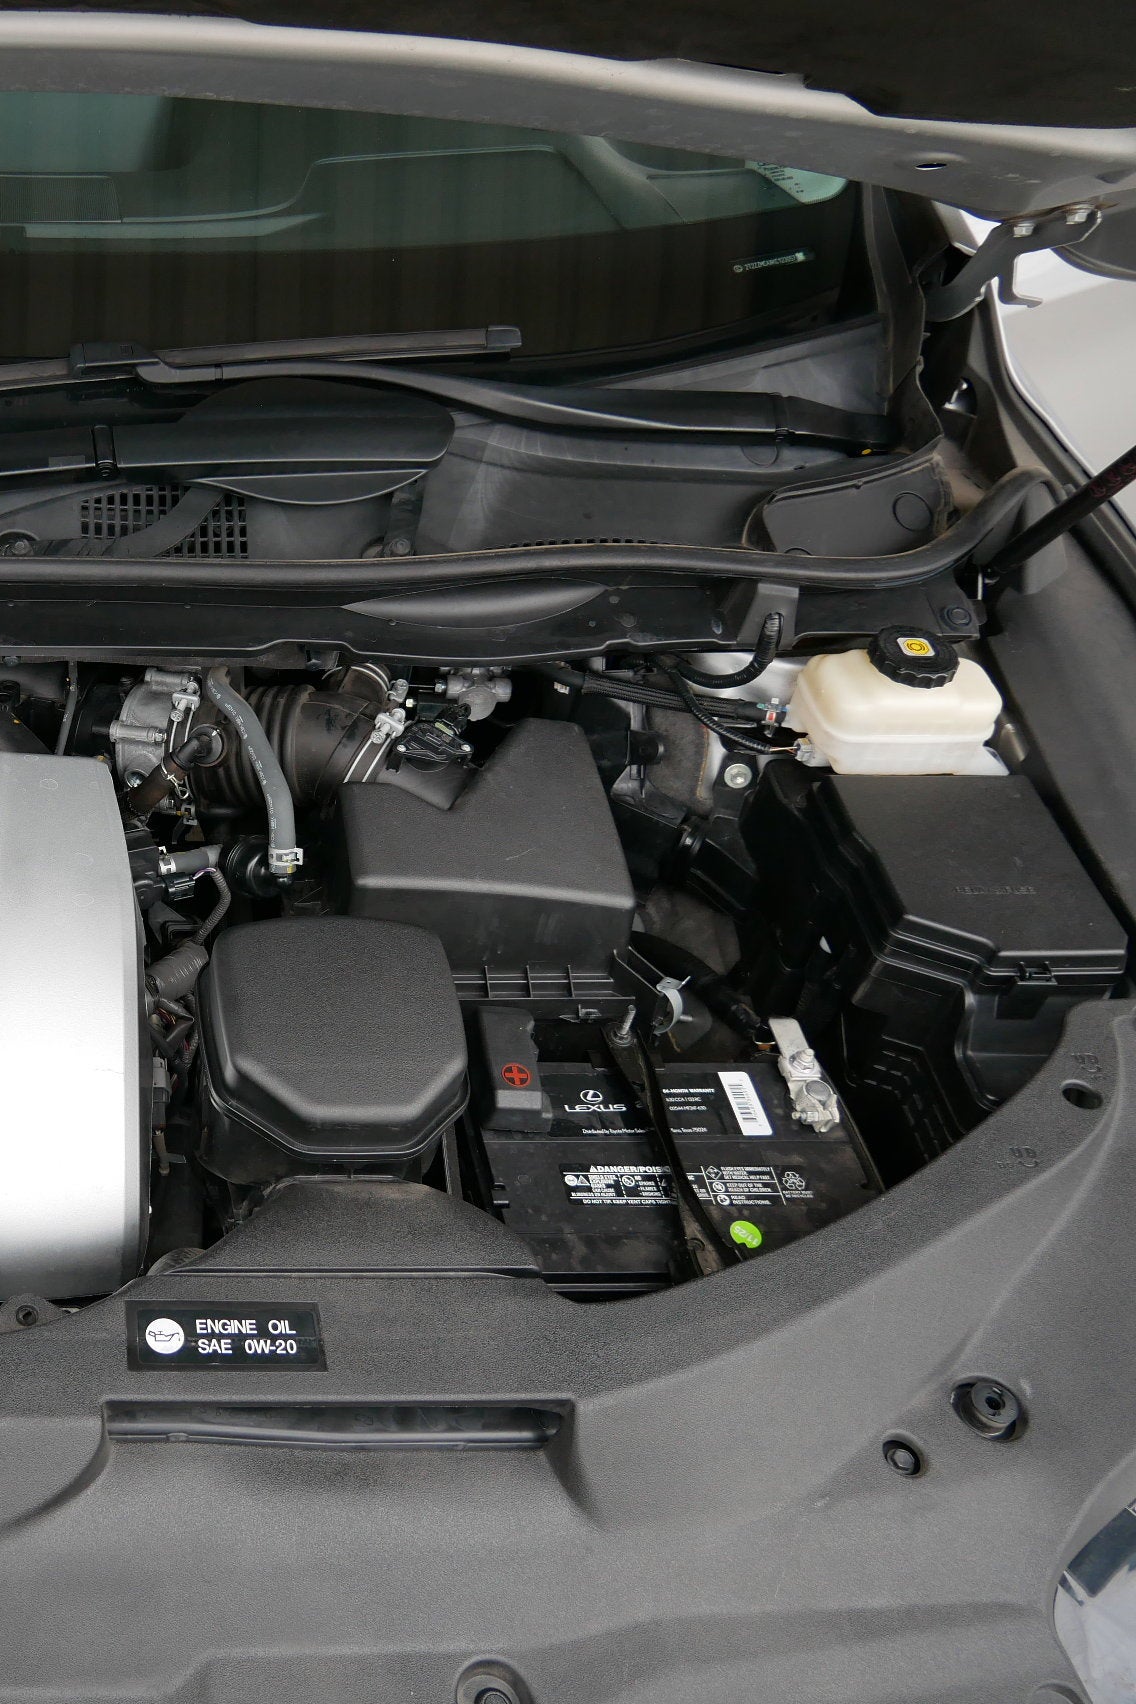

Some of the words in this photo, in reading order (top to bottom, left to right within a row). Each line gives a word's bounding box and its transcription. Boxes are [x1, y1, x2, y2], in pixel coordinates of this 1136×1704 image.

[564, 1104, 627, 1112] LEXUS
[195, 1319, 258, 1334] ENGINE
[268, 1319, 297, 1334] OIL
[197, 1339, 233, 1354] SAE
[244, 1339, 297, 1354] 0W-20
